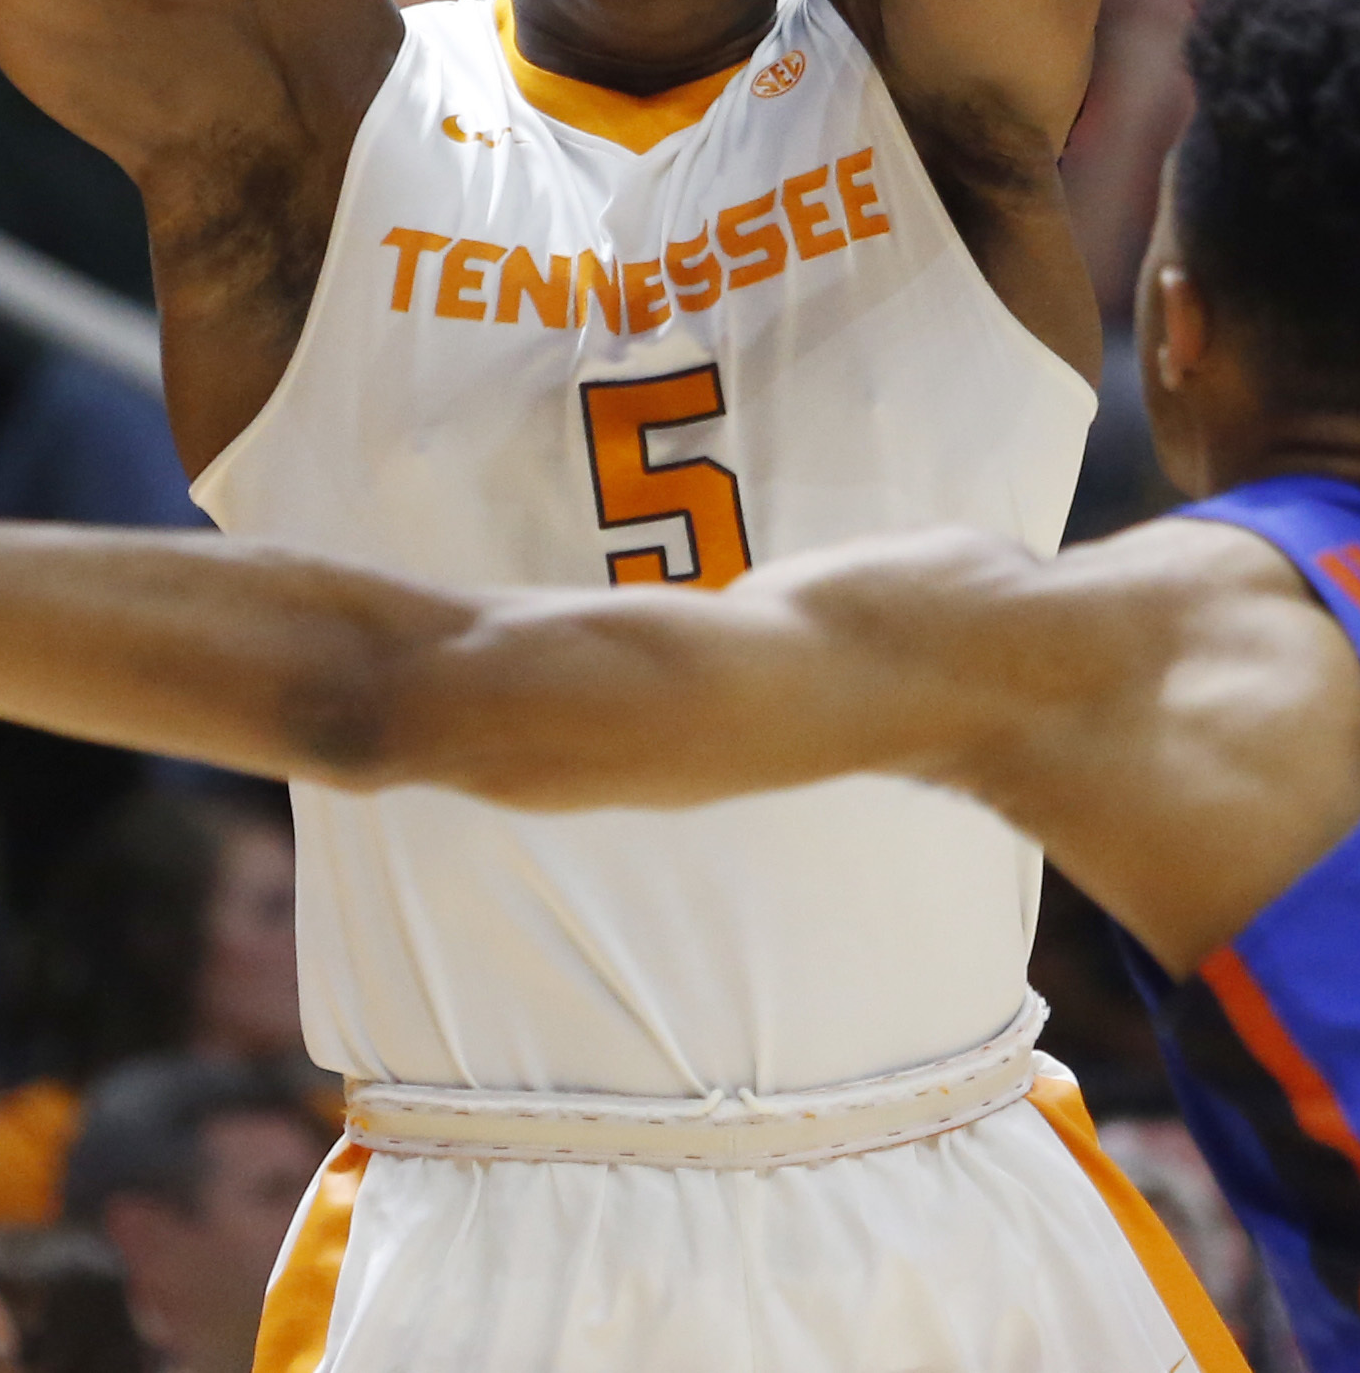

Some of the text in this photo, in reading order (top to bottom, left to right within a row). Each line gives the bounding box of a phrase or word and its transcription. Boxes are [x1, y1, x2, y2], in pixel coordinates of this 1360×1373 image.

[754, 53, 802, 93] SEC
[380, 146, 890, 336] TENNESSEE
[579, 361, 753, 588] 5
